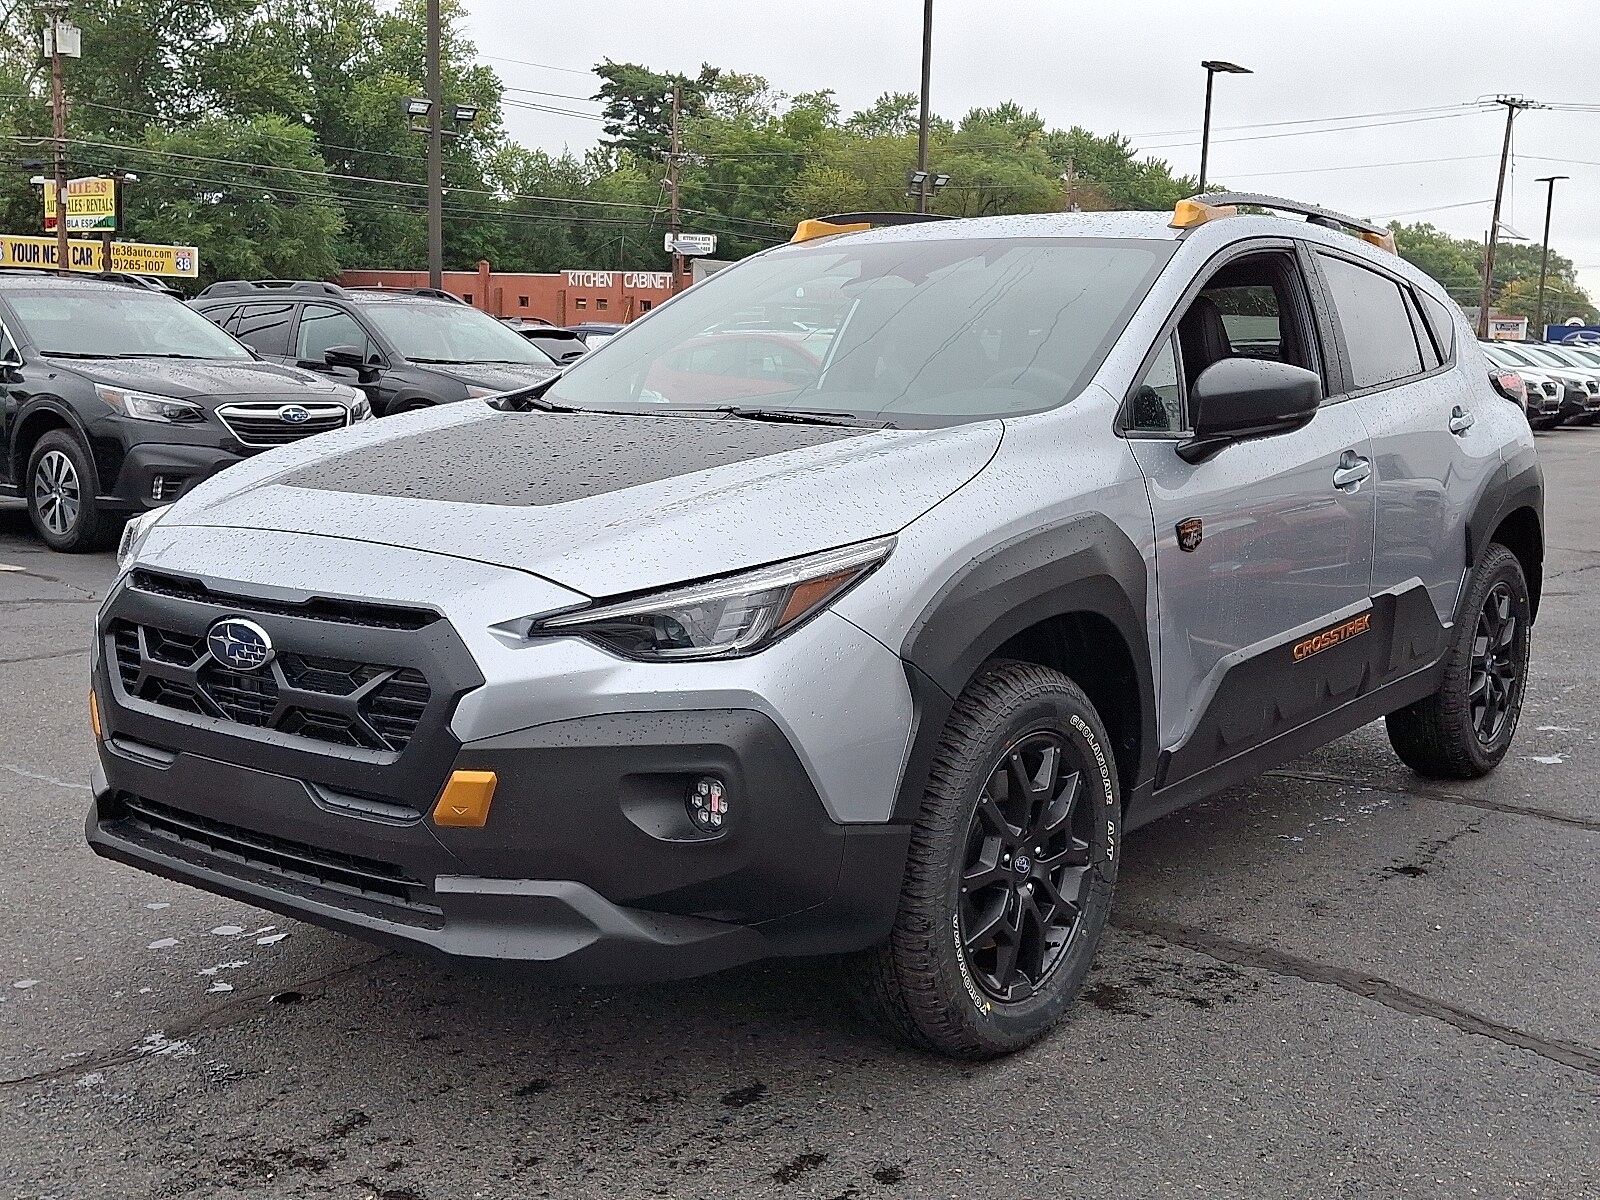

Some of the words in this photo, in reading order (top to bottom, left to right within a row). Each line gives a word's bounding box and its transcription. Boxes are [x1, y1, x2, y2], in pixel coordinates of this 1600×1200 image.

[51, 181, 91, 195] UTE
[94, 182, 107, 193] 38
[66, 199, 83, 213] ALES
[87, 197, 114, 212] RENTALS
[81, 216, 110, 229] ESPAÑOL
[10, 242, 40, 264] YOUR
[73, 246, 93, 267] CAR
[97, 245, 172, 260] rte38auto.com
[97, 256, 165, 272] (9)265-1007
[176, 257, 191, 271] 38
[568, 272, 613, 287] KITCHEN
[624, 273, 673, 289] CABINET
[1293, 614, 1371, 661] CROSSTREK
[1069, 714, 1114, 806] GEOLANDAR
[1106, 820, 1115, 861] A/T
